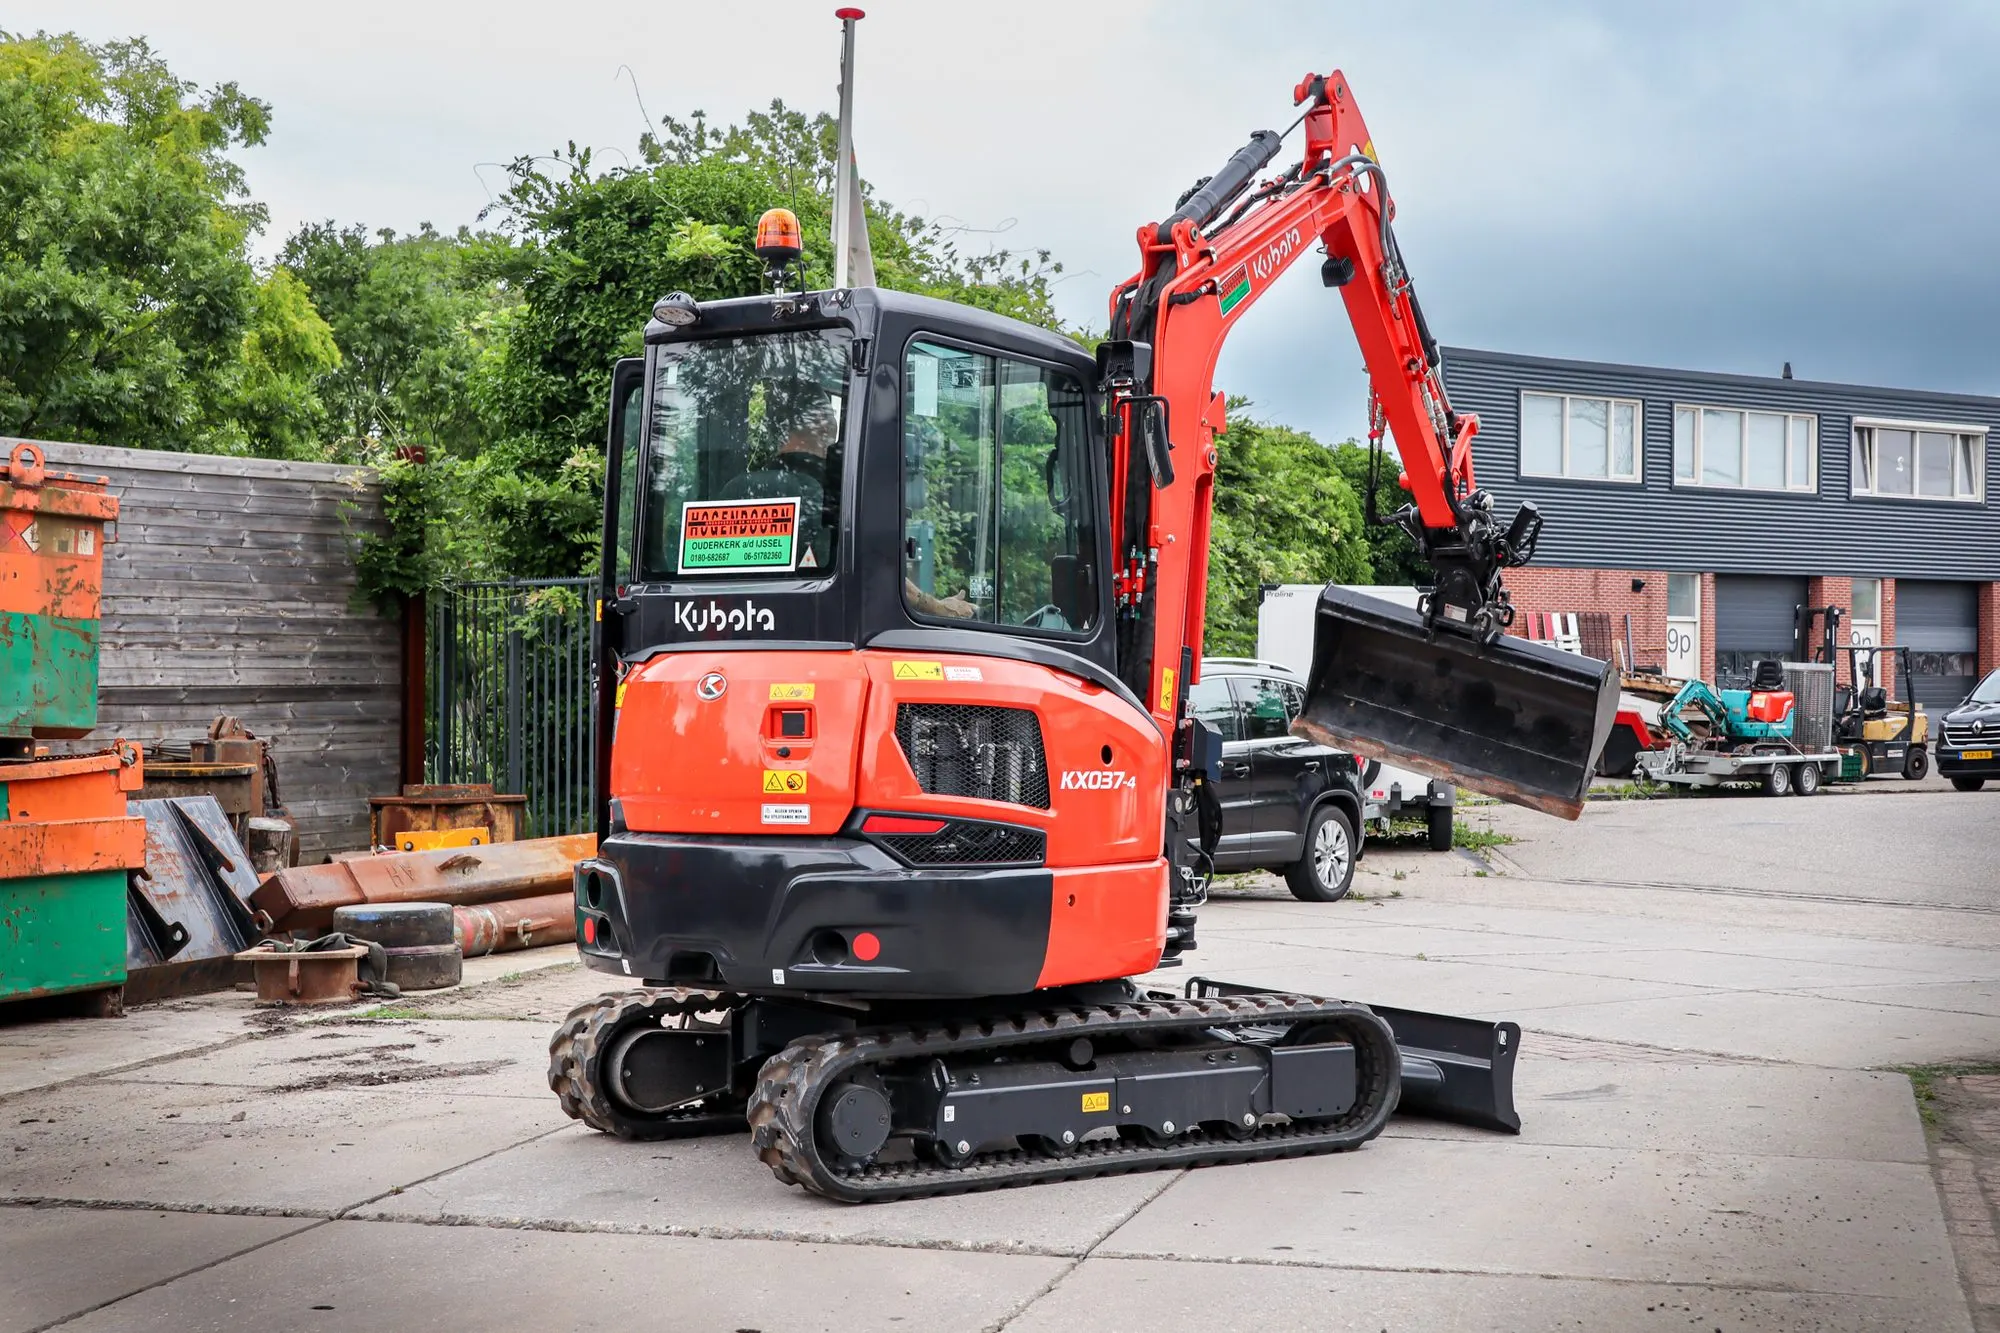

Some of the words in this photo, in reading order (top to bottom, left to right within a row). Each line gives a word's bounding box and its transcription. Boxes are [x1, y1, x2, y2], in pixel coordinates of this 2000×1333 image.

[1252, 228, 1301, 279] Kubota
[690, 508, 789, 537] HOGENDOORN
[691, 540, 740, 551] OUDERKERK
[742, 540, 754, 549] a/d
[755, 538, 783, 549] IJSSEL
[690, 552, 730, 563] 0180-682687
[743, 551, 782, 561] 06-51782360
[1265, 590, 1294, 598] Proline
[674, 600, 775, 632] Kubota
[1667, 627, 1692, 660] 9p
[1060, 770, 1136, 790] KX037-4
